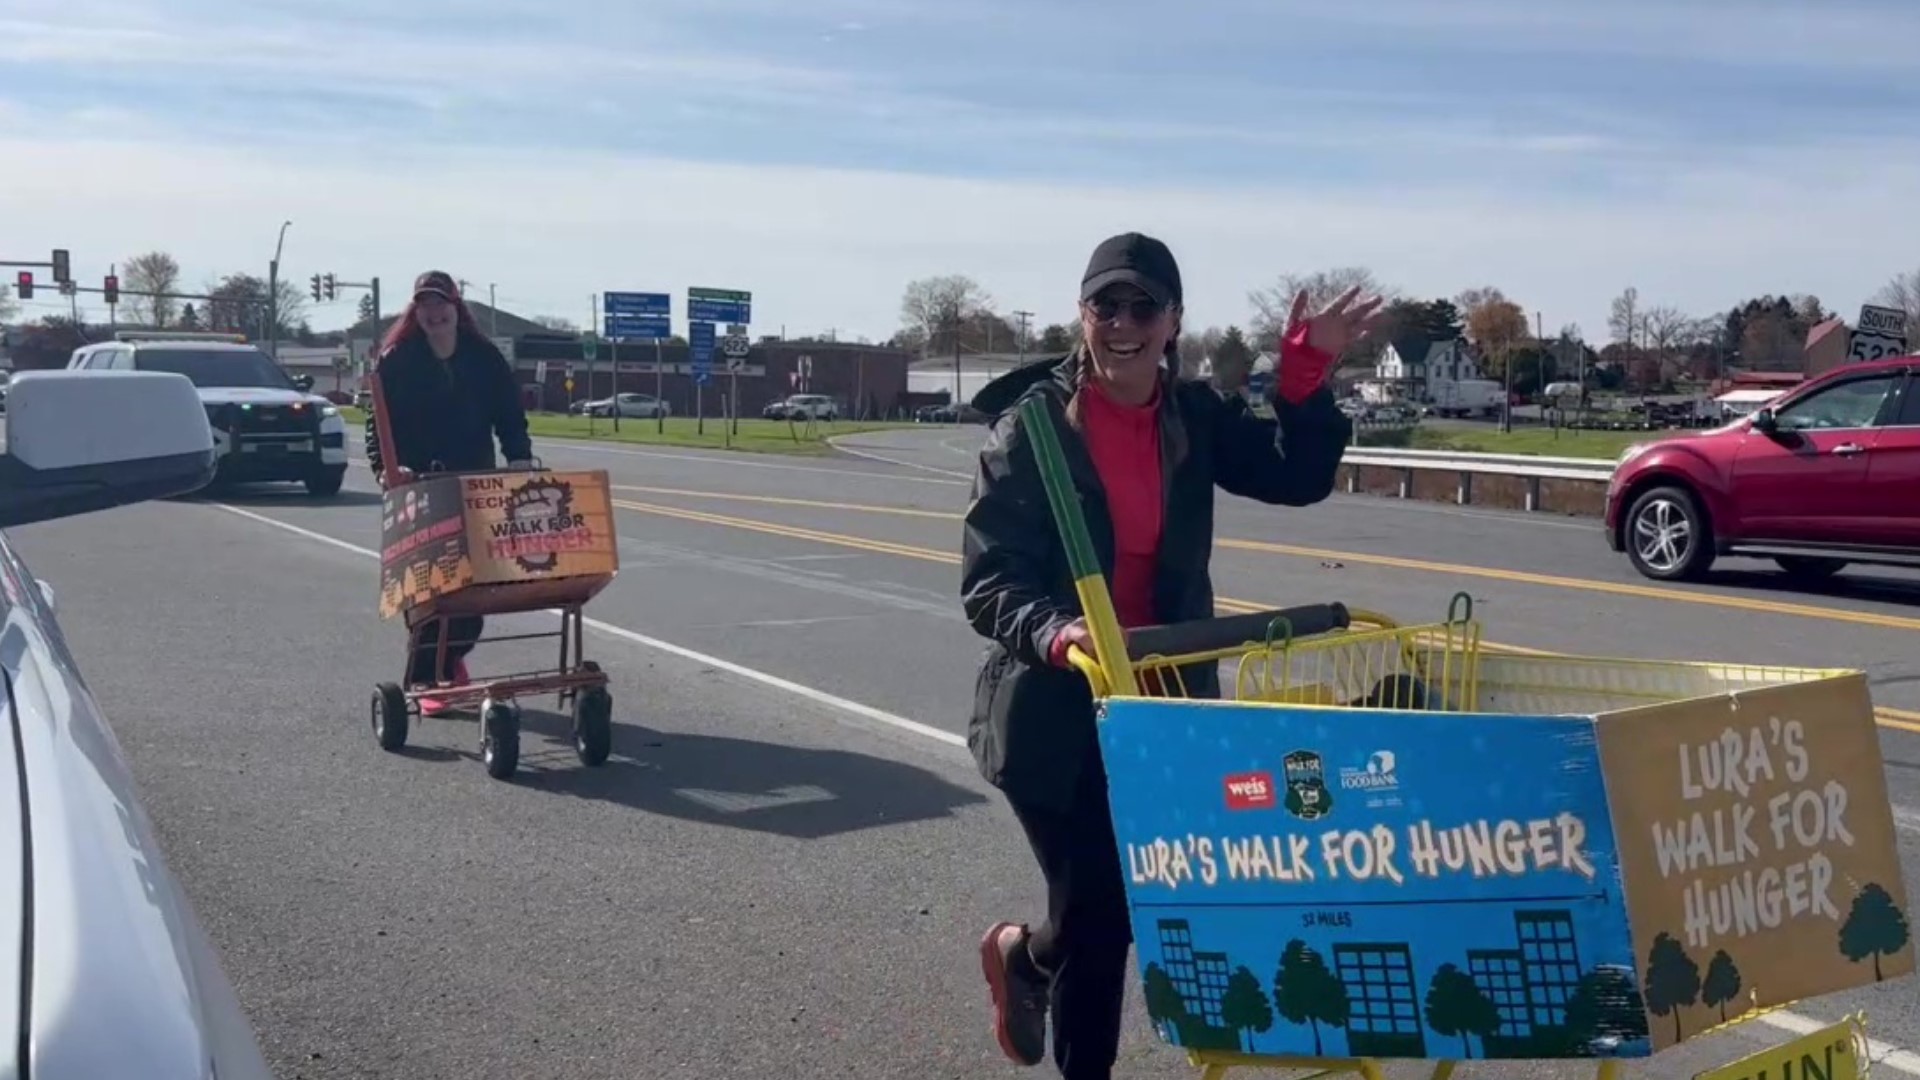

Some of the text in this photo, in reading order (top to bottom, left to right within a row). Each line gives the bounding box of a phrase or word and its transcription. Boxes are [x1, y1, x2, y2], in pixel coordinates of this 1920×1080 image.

[1862, 309, 1902, 331] SOUTH
[725, 340, 747, 353] 522
[467, 477, 504, 490] SUN
[466, 495, 513, 509] TECH
[490, 513, 585, 537] WALK FOR
[485, 527, 593, 558] HUNGER
[1679, 716, 1809, 799] LURA'S
[1228, 777, 1267, 796] weis
[1651, 780, 1855, 878] WALK FOR
[1128, 811, 1596, 889] LURA'S WALK FOR HUNGER
[1683, 852, 1839, 948] HUNGER
[1317, 910, 1352, 928] MILES
